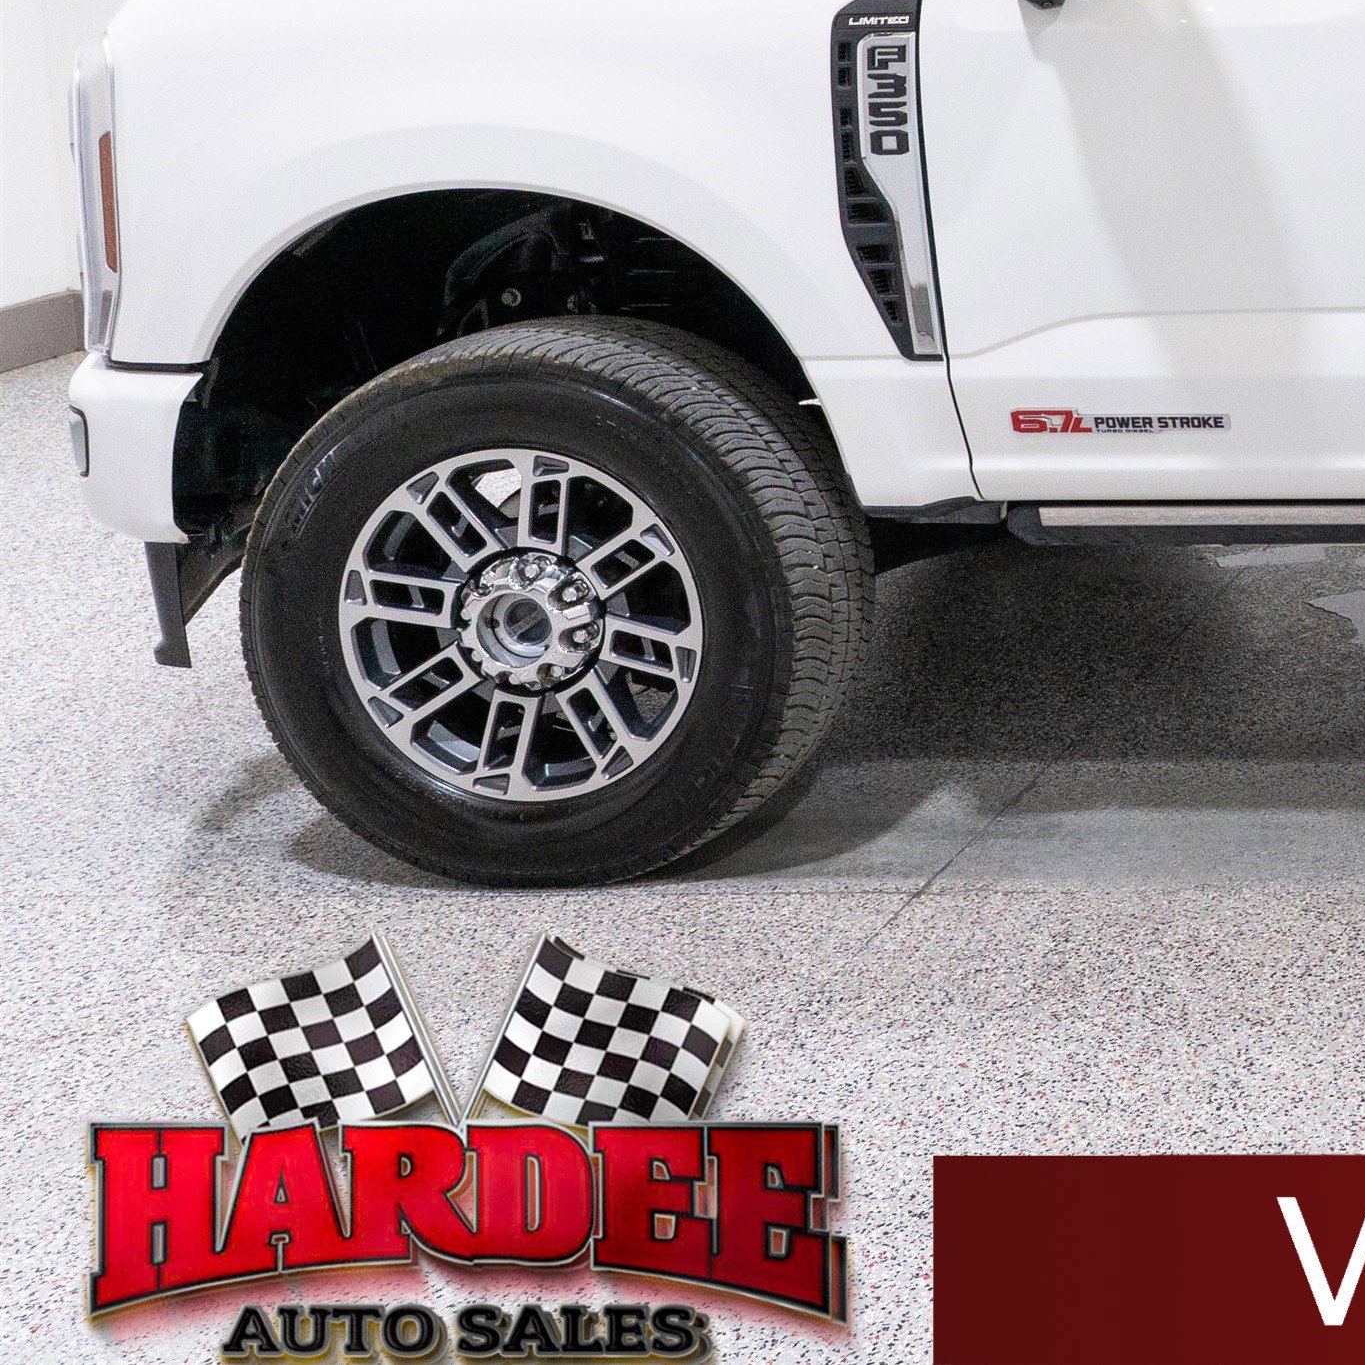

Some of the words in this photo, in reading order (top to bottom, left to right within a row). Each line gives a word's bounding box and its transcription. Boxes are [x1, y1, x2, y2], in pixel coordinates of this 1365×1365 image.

[848, 15, 910, 26] LIMITED
[866, 44, 911, 156] F350
[1010, 410, 1093, 433] 6.7L
[1093, 416, 1154, 429] POWER
[1157, 416, 1226, 429] STROKE
